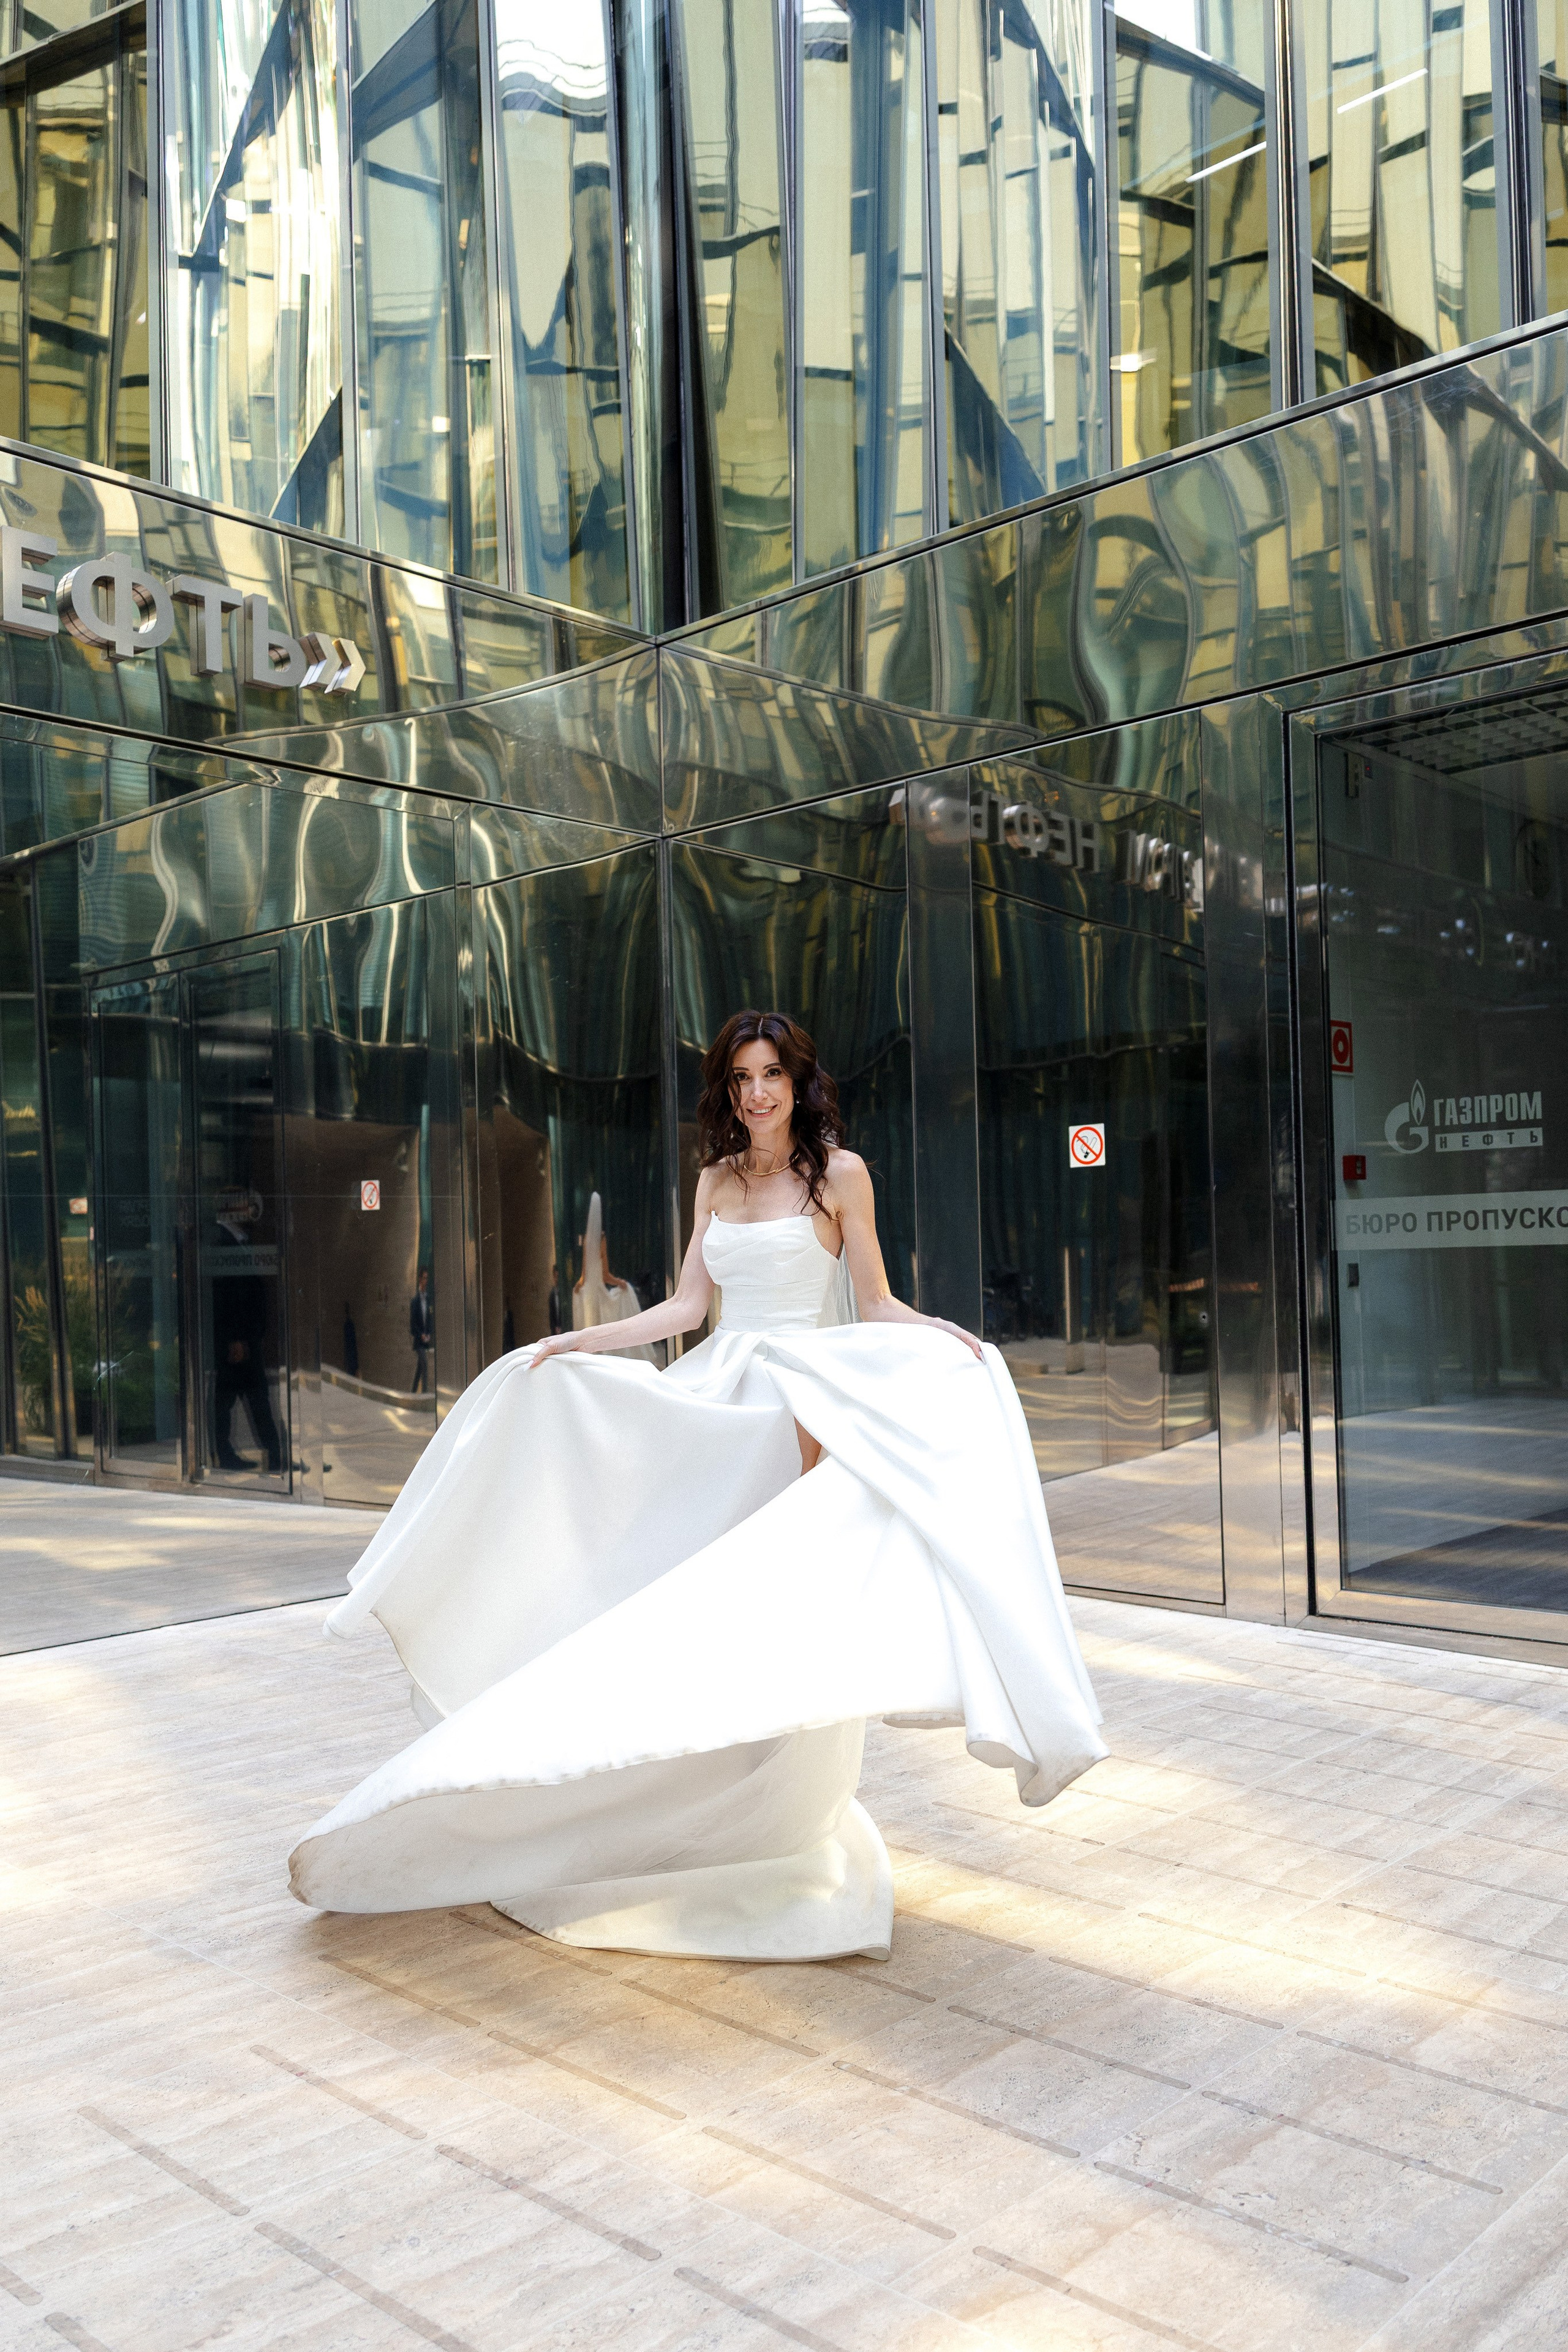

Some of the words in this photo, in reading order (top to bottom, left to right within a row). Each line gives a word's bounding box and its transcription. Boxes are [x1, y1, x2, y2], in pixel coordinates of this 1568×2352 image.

[1433, 1090, 1543, 1127] ГАЗПРОМ
[1439, 1130, 1539, 1150] НЕФТЬ
[1347, 1212, 1418, 1235] БЮРО
[1426, 1205, 1568, 1233] ПРОПУСКО
